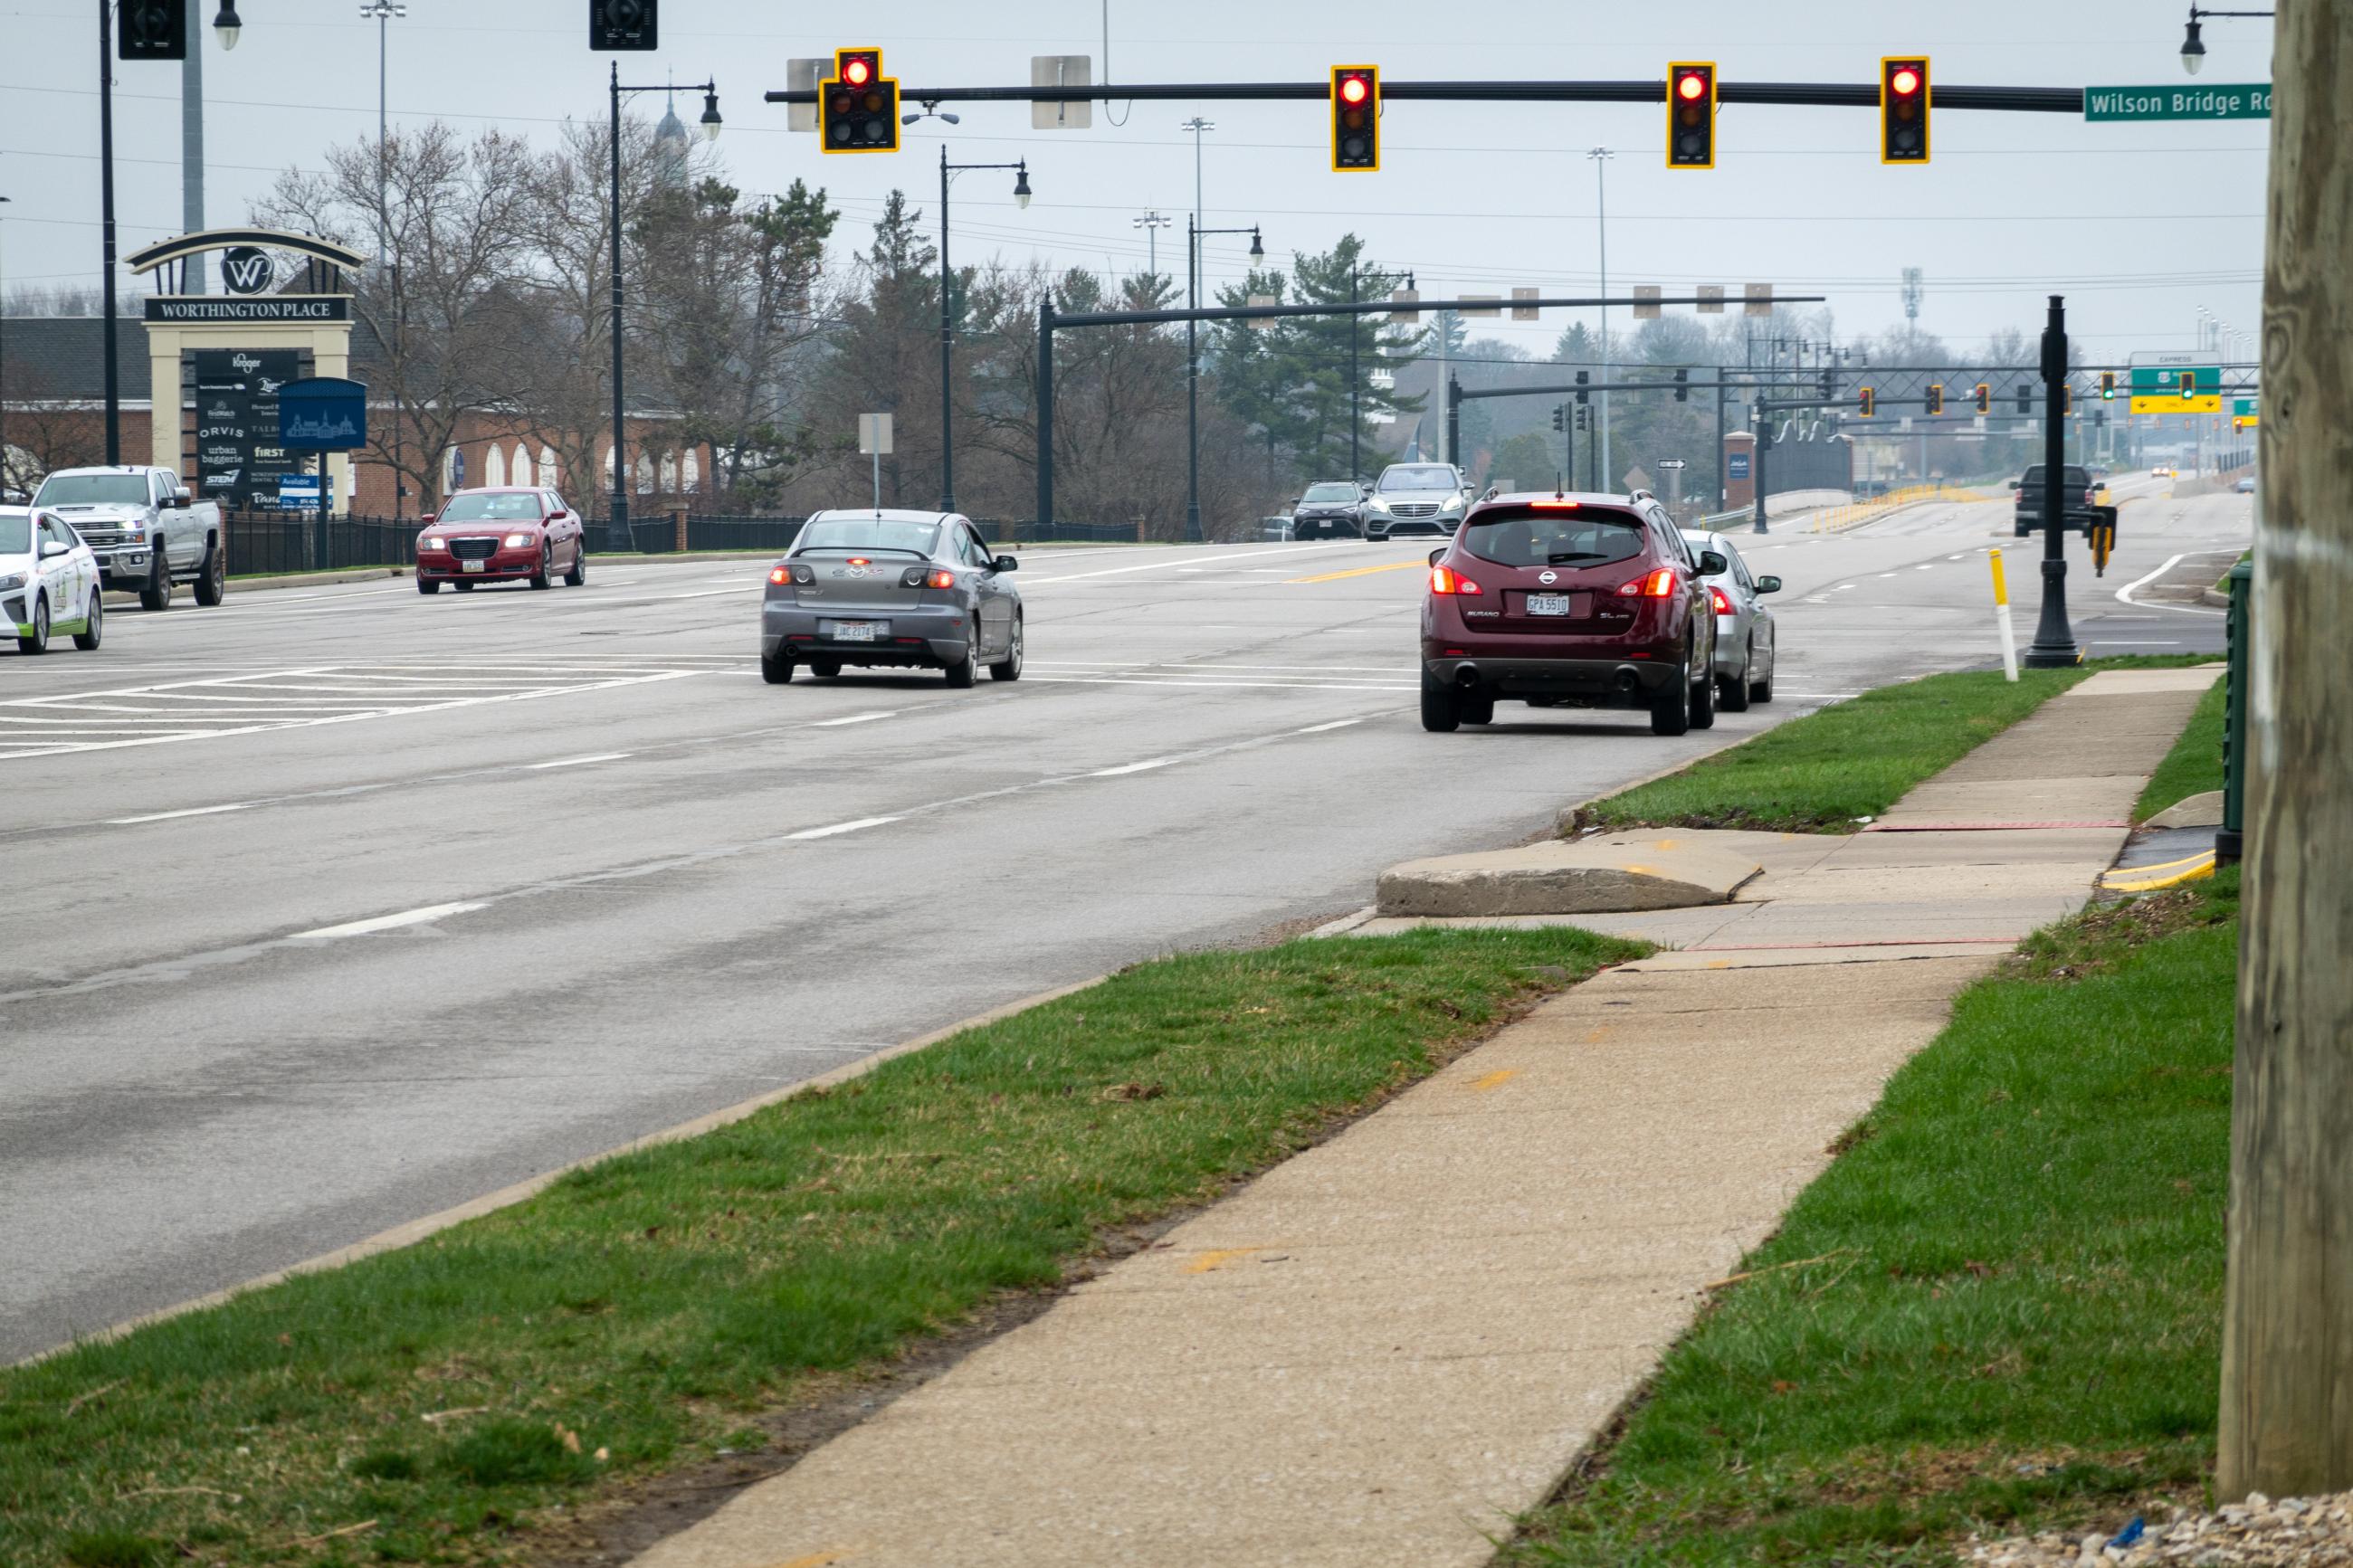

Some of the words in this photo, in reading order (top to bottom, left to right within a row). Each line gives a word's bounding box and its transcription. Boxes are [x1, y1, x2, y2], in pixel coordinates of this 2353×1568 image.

[2091, 93, 2163, 113] Wilson
[2172, 91, 2242, 116] Bridge
[160, 303, 281, 318] WORTHINGTON
[282, 303, 331, 317] PLACE
[233, 353, 262, 374] Kroger
[199, 426, 244, 438] ORVIS
[207, 446, 237, 454] urban
[202, 454, 244, 465] baggerie
[205, 475, 236, 484] STEM
